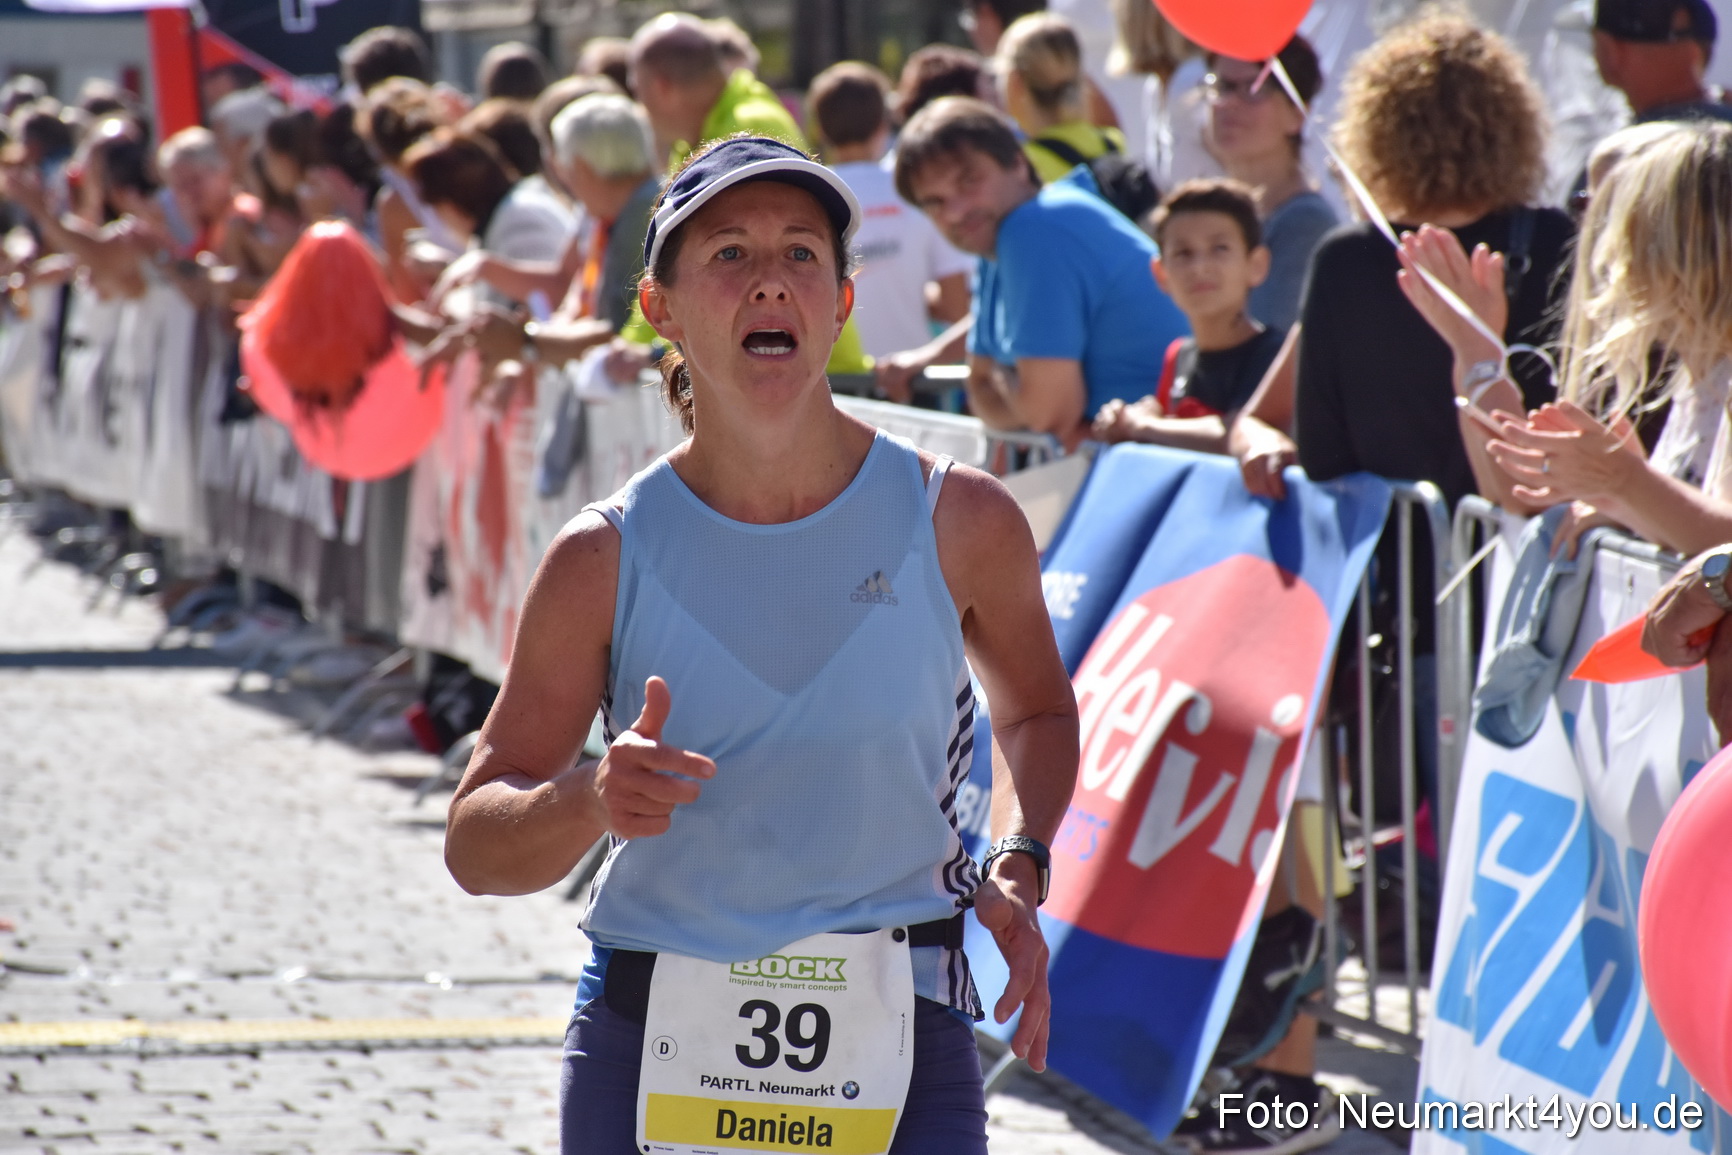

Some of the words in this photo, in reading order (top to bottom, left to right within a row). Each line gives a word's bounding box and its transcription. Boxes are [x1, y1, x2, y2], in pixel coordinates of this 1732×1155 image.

[850, 591, 899, 606] adidas
[730, 954, 848, 982] BOCK
[729, 976, 764, 987] inspired
[766, 980, 777, 990] by
[780, 982, 806, 990] smart
[808, 983, 848, 993] concepts
[660, 1041, 669, 1055] D
[735, 999, 831, 1073] 39
[700, 1074, 754, 1092] PARTL
[759, 1081, 835, 1098] Neumarkt
[716, 1109, 833, 1147] Daniela
